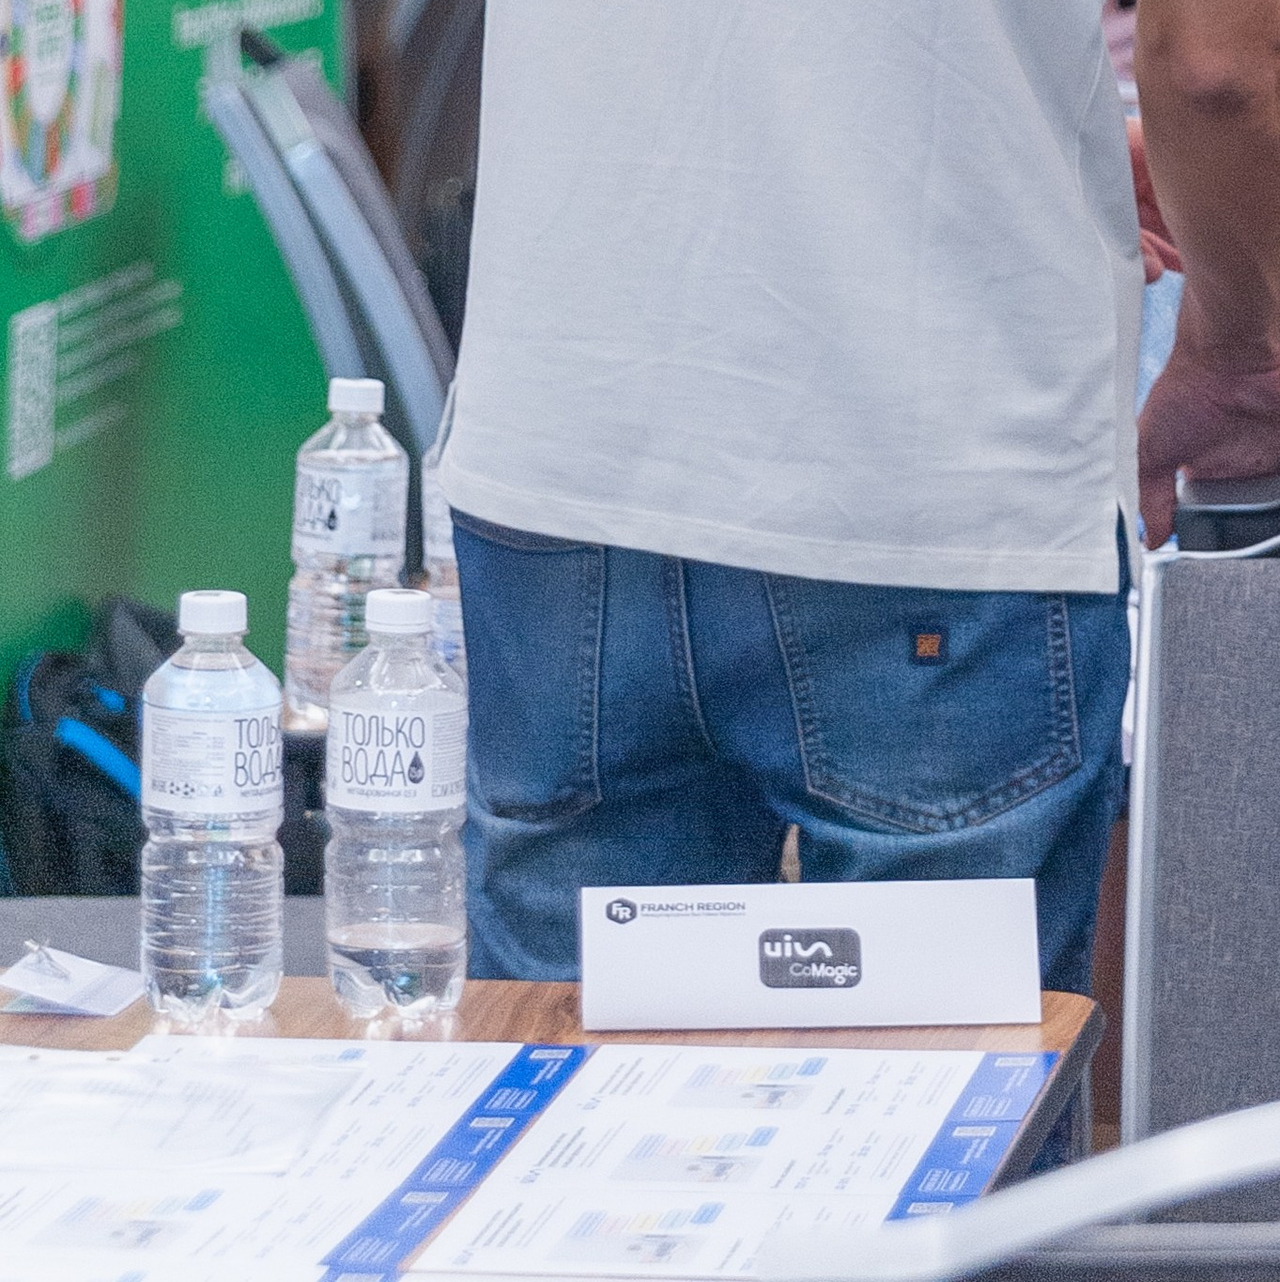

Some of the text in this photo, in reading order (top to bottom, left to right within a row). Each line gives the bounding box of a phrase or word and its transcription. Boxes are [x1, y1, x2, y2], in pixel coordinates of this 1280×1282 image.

[234, 716, 281, 749] ТОЛЬ
[342, 711, 425, 748] ТОЛЬКО
[342, 746, 407, 787] ВОДА
[641, 901, 746, 912] FRANCH REGION
[789, 961, 858, 985] CoMagic
